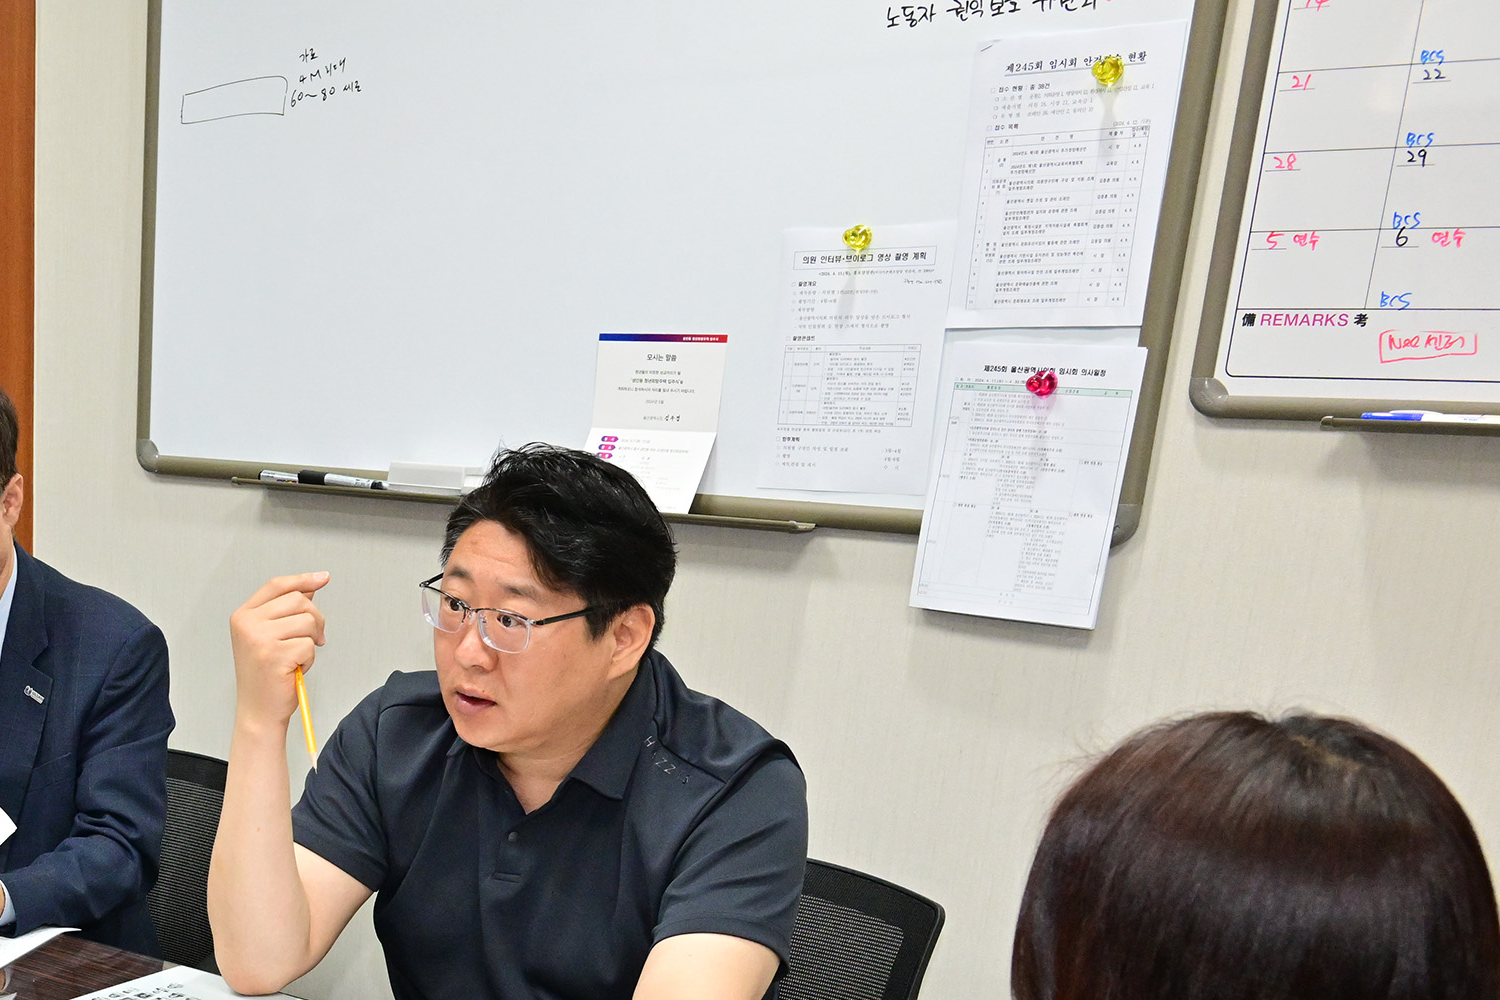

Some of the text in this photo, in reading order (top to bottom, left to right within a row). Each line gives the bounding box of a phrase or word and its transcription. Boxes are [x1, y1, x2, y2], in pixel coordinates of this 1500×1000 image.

[887, 5, 937, 28] 노동자
[1005, 60, 1043, 73] 제245회
[1049, 57, 1078, 70] 임시회
[1128, 51, 1147, 62] 현황
[1419, 49, 1445, 65] BCS
[1291, 73, 1312, 90] 21
[1423, 68, 1447, 81] 22
[1406, 132, 1435, 148] BCS
[1273, 153, 1298, 170] 28
[1406, 149, 1428, 168] 29
[1392, 211, 1421, 230] BCS
[1266, 231, 1321, 251] 5 연수
[1395, 226, 1466, 248] 6 연수
[802, 251, 927, 264] 의원 인터뷰·브이로그 영상 촬영 계획
[1379, 291, 1413, 311] BCS
[1260, 313, 1349, 327] REMARKS
[1353, 313, 1369, 328] 考
[646, 354, 677, 362] 모시는 말씀
[983, 365, 1008, 373] 제245회
[1058, 368, 1078, 376] 임시회
[1080, 368, 1107, 377] 의사일정
